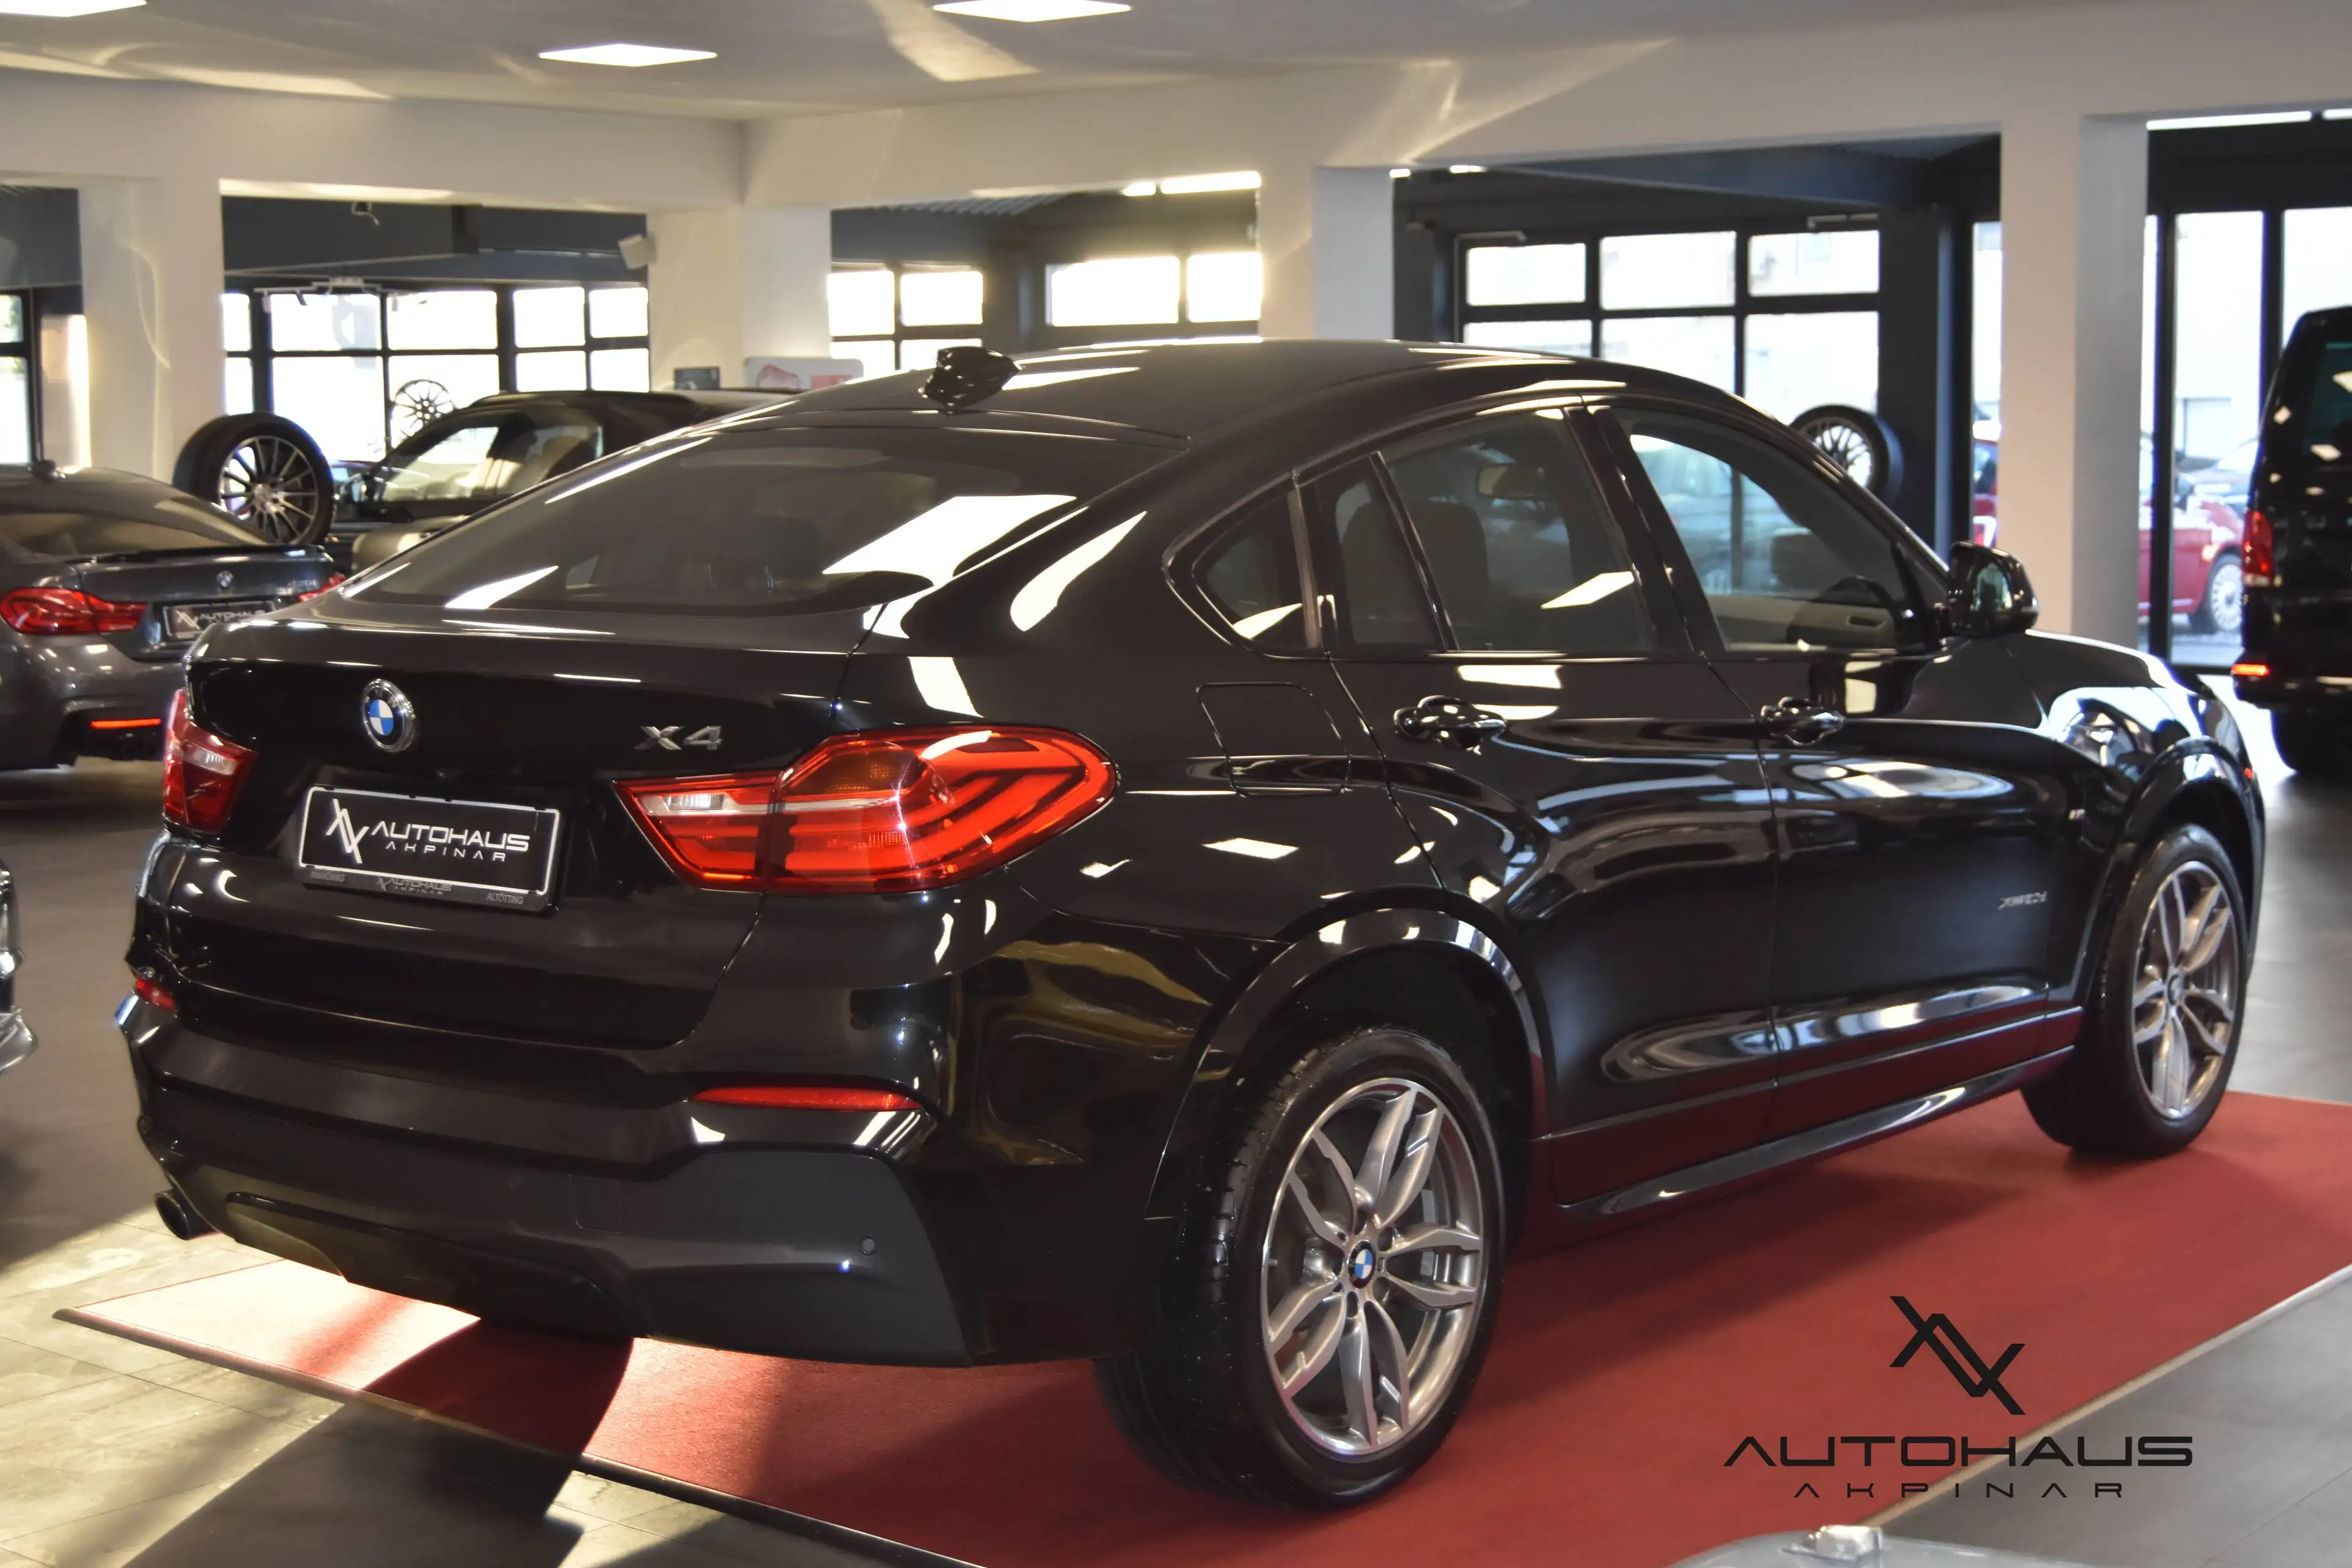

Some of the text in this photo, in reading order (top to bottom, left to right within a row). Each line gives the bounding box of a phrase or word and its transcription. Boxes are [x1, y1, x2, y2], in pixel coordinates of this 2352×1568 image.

[633, 725, 723, 750] X4
[371, 821, 530, 851] AUTOHAUS
[385, 842, 506, 862] AKPINAR
